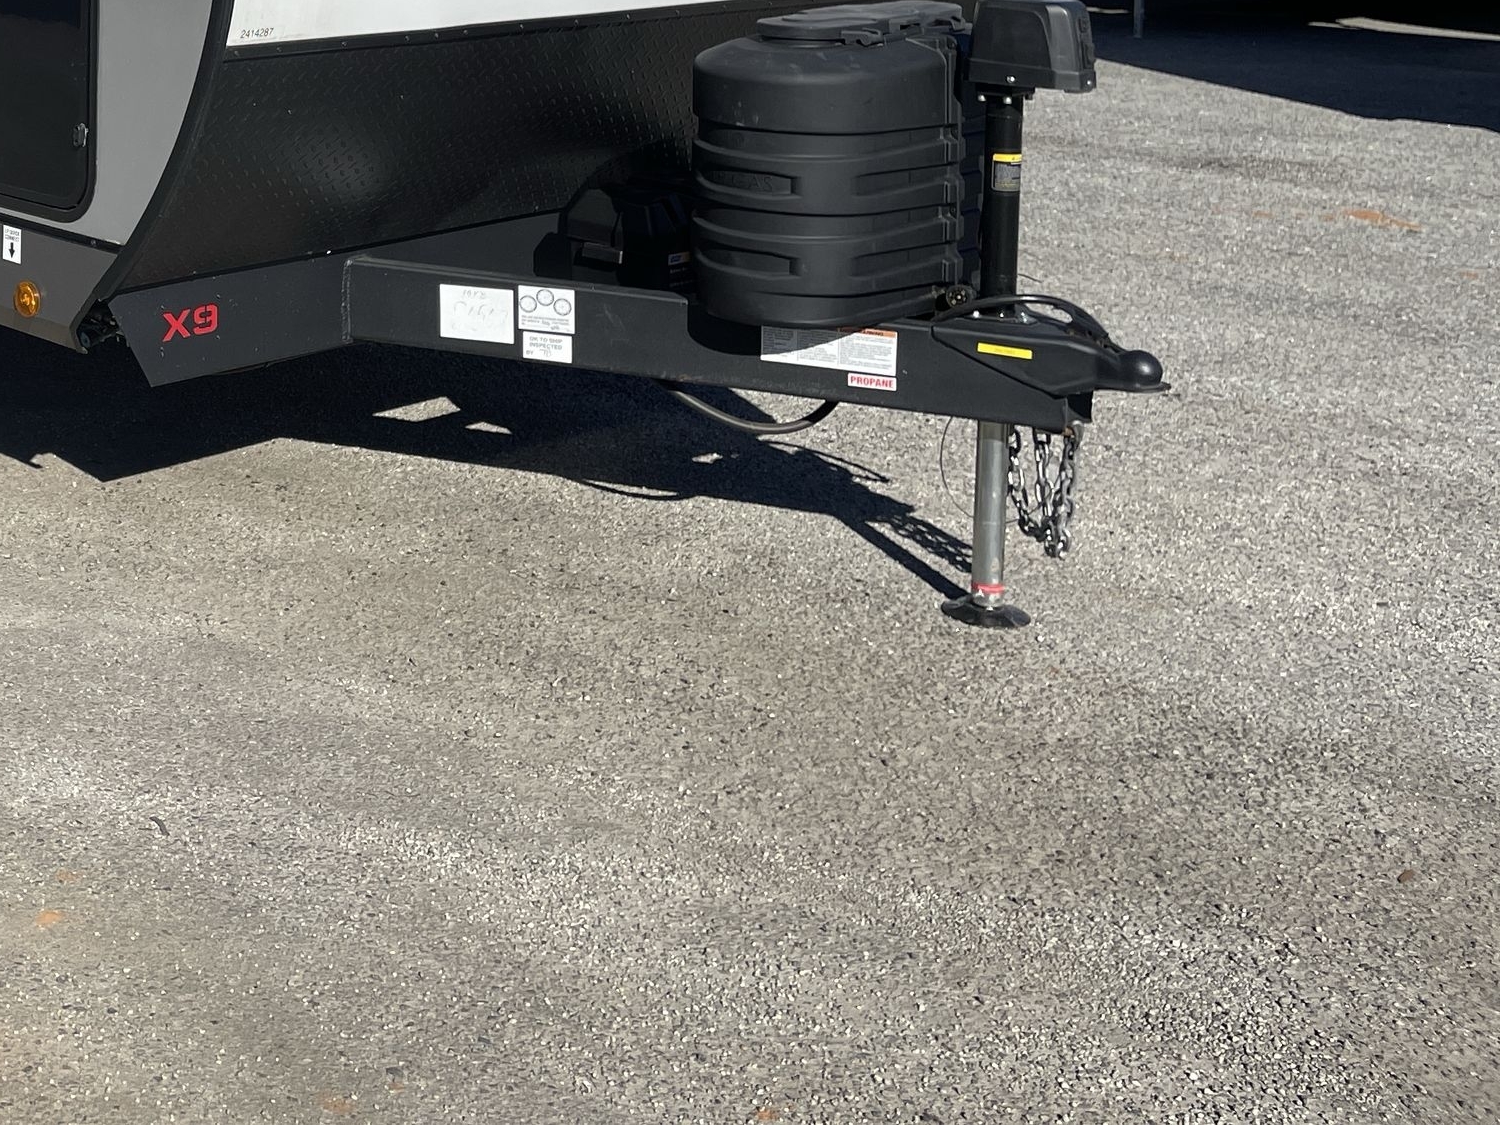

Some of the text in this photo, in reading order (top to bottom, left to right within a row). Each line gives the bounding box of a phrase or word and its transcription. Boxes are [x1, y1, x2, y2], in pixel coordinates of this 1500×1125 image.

[240, 27, 274, 39] 2414287
[162, 304, 218, 342] X9
[529, 342, 563, 350] INSPECTED
[850, 375, 894, 388] PROPANE
